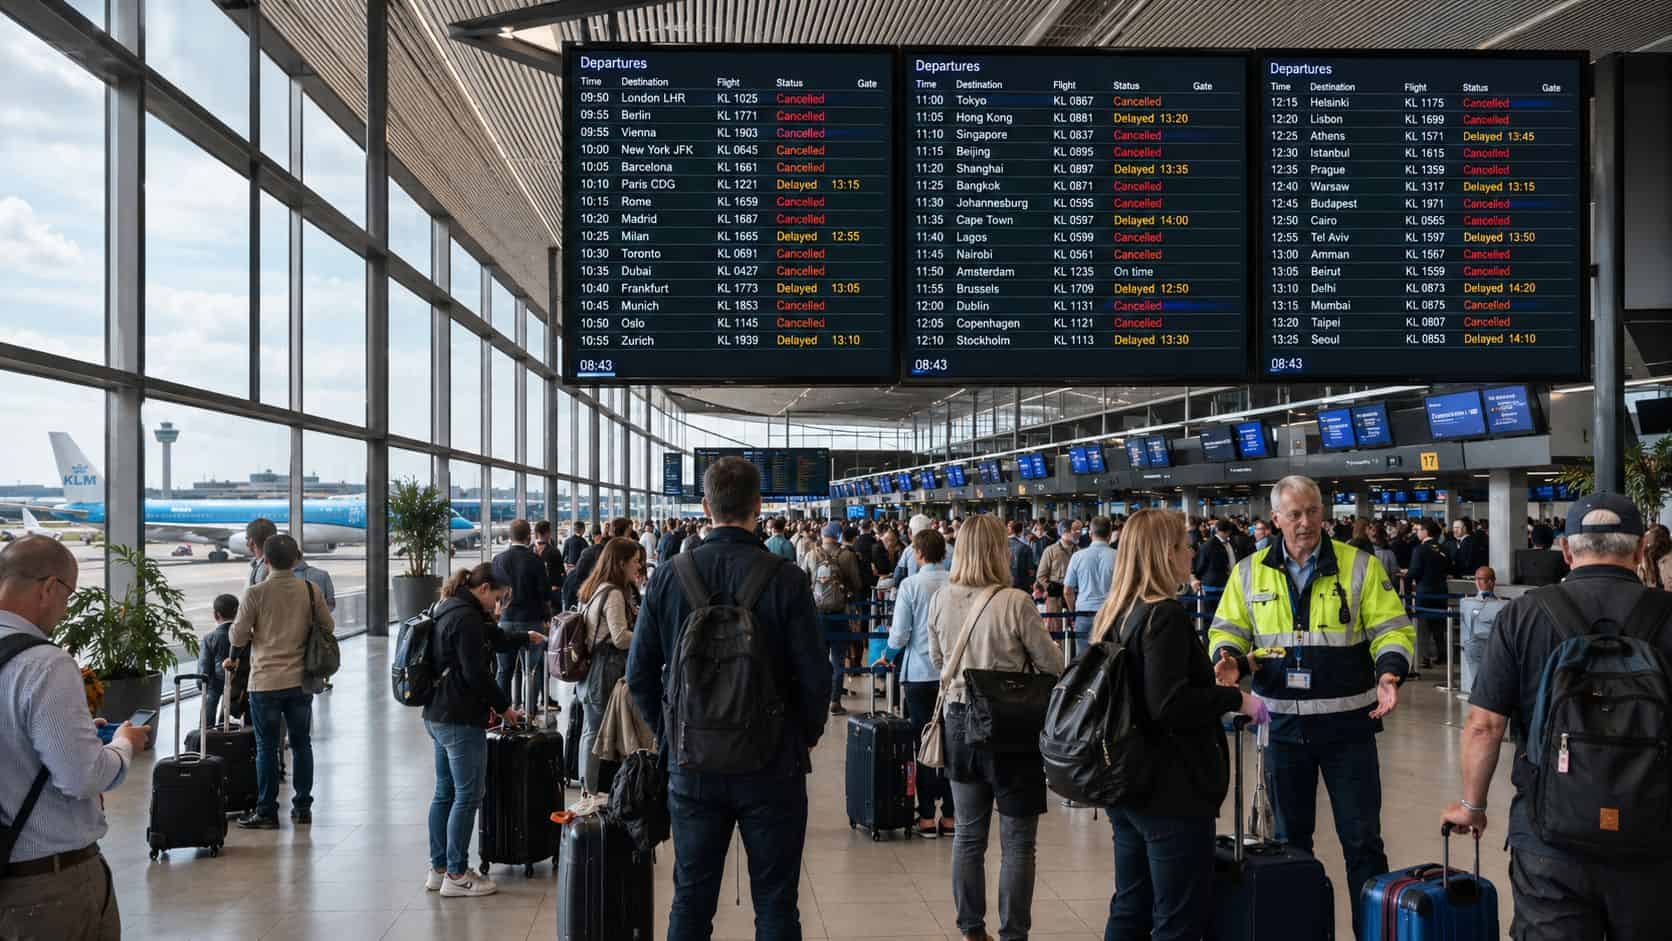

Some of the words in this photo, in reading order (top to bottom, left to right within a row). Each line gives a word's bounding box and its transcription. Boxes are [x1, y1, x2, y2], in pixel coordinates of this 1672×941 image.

[581, 56, 647, 71] Departures
[916, 60, 980, 74] Departures
[1270, 63, 1332, 76] Departures
[581, 77, 601, 86] Time
[621, 77, 668, 86] Destination
[717, 78, 740, 88] Flight
[776, 78, 803, 87] Status
[857, 79, 877, 88] Gate
[916, 80, 936, 88] Time
[956, 80, 1002, 88] Destination
[1054, 81, 1076, 91] Flight
[1113, 81, 1140, 90] Status
[1193, 82, 1212, 90] Gate
[1271, 82, 1291, 91] Time
[1310, 82, 1355, 91] Destination
[1405, 83, 1427, 93] Flight
[1463, 83, 1488, 92] Status
[1542, 84, 1560, 92] Gate
[581, 92, 609, 102] 09:50
[622, 93, 660, 103] London
[664, 93, 685, 103] LHR
[917, 95, 943, 104] 11:00
[956, 95, 987, 107] Tokyo
[1272, 97, 1298, 107] 12:15
[1311, 97, 1349, 107] Helsinki
[581, 110, 608, 119] 09:55
[622, 110, 650, 120] Berlin
[917, 112, 943, 121] 11:05
[957, 112, 983, 124] Hong
[987, 113, 1012, 124] Kong
[1114, 113, 1154, 124] Delayed
[1160, 114, 1188, 123] 13:20
[1272, 114, 1298, 124] 12:20
[1311, 114, 1343, 124] Lisbon
[581, 127, 609, 136] 09:55
[621, 127, 656, 137] Vienna
[917, 129, 943, 138] 11:10
[957, 129, 1007, 141] Singapore
[1272, 131, 1298, 140] 12:25
[1311, 131, 1345, 140] Athens
[1464, 132, 1502, 143] Delayed
[1509, 132, 1534, 140] 13:45
[582, 144, 609, 154] 10:00
[622, 145, 644, 154] New
[648, 144, 670, 154] York
[674, 145, 693, 154] JFK
[917, 146, 943, 156] 11:15
[957, 146, 990, 159] Beijing
[1272, 148, 1298, 157] 12:30
[1311, 148, 1349, 157] Istanbul
[582, 162, 608, 171] 10:05
[622, 162, 672, 172] Barcelona
[917, 163, 943, 173] 11:20
[957, 164, 1003, 175] Shanghai
[1115, 165, 1154, 176] Delayed
[1160, 164, 1188, 174] 13:35
[1272, 165, 1298, 174] 12:35
[1311, 165, 1345, 176] Prague
[582, 179, 609, 188] 10:10
[622, 179, 647, 189] Paris
[651, 179, 675, 189] CDG
[777, 180, 817, 192] Delayed
[833, 180, 859, 189] 13:15
[917, 180, 943, 190] 11:25
[957, 180, 1000, 192] Bangkok
[1272, 181, 1298, 191] 12:40
[1310, 182, 1349, 191] Warsaw
[1464, 182, 1502, 193] Delayed
[1509, 182, 1535, 191] 13:15
[582, 196, 608, 206] 10:15
[622, 196, 651, 206] Rome
[917, 198, 943, 207] 11:30
[957, 198, 1028, 209] Johannesburg
[1272, 198, 1298, 208] 12:45
[1311, 199, 1357, 210] Budapest
[581, 214, 609, 223] 10:20
[622, 214, 657, 224] Madrid
[917, 215, 943, 224] 11:35
[957, 215, 984, 227] Cape
[987, 215, 1013, 224] Town
[1115, 216, 1154, 227] Delayed
[1162, 216, 1188, 225] 14:00
[1272, 216, 1298, 225] 12:50
[1311, 216, 1337, 225] Cairo
[582, 231, 609, 240] 10:25
[622, 231, 649, 240] Milan
[777, 231, 817, 243] Delayed
[832, 232, 859, 240] 12:55
[917, 232, 943, 242] 11:40
[957, 232, 987, 244] Lagos
[1272, 232, 1298, 242] 12:55
[1311, 232, 1326, 242] Tel
[1328, 232, 1349, 242] Aviv
[1464, 232, 1503, 244] Delayed
[1510, 232, 1535, 241] 13:50
[582, 248, 608, 258] 10:30
[621, 248, 661, 258] Toronto
[917, 249, 943, 259] 11:45
[957, 249, 992, 259] Nairobi
[1272, 249, 1298, 259] 13:00
[1311, 250, 1349, 259] Amman
[582, 266, 609, 275] 10:35
[622, 266, 651, 276] Dubai
[917, 266, 943, 276] 11:50
[956, 267, 1014, 276] Amsterdam
[1114, 267, 1128, 276] On
[1132, 267, 1153, 276] time
[1272, 266, 1298, 276] 13:05
[1312, 266, 1340, 276] Beirut
[582, 283, 609, 293] 10:40
[622, 283, 668, 293] Frankfurt
[777, 283, 817, 295] Delayed
[832, 283, 859, 293] 13:05
[917, 284, 943, 293] 11:55
[957, 284, 999, 293] Brussels
[1115, 284, 1154, 296] Delayed
[1162, 284, 1188, 293] 12:50
[1272, 284, 1298, 293] 13:10
[1312, 283, 1336, 293] Delhi
[1465, 283, 1503, 295] Delayed
[1510, 283, 1535, 292] 14:20
[581, 301, 609, 310] 10:45
[622, 301, 659, 311] Munich
[917, 301, 943, 310] 12:00
[957, 301, 989, 310] Dublin
[1273, 301, 1298, 310] 13:15
[1311, 301, 1350, 310] Mumbai
[581, 318, 608, 328] 10:50
[621, 318, 645, 328] Oslo
[917, 318, 943, 328] 12:05
[957, 318, 1020, 330] Copenhagen
[1272, 318, 1298, 327] 13:20
[1312, 317, 1340, 329] Taipei
[582, 336, 608, 345] 10:55
[622, 336, 654, 345] Zurich
[778, 335, 817, 347] Delayed
[833, 335, 860, 344] 13:10
[917, 336, 943, 345] 12:10
[957, 335, 1010, 345] Stockholm
[1115, 335, 1155, 346] Delayed
[1162, 335, 1189, 344] 13:30
[1272, 334, 1298, 344] 13:25
[1312, 334, 1339, 344] Seoul
[1465, 334, 1503, 345] Delayed
[1510, 334, 1536, 343] 14:10
[578, 359, 615, 371] 08:43
[915, 359, 947, 371] 08:43
[1270, 358, 1302, 370] 08:43
[1423, 455, 1435, 466] 17
[63, 474, 97, 486] KLM
